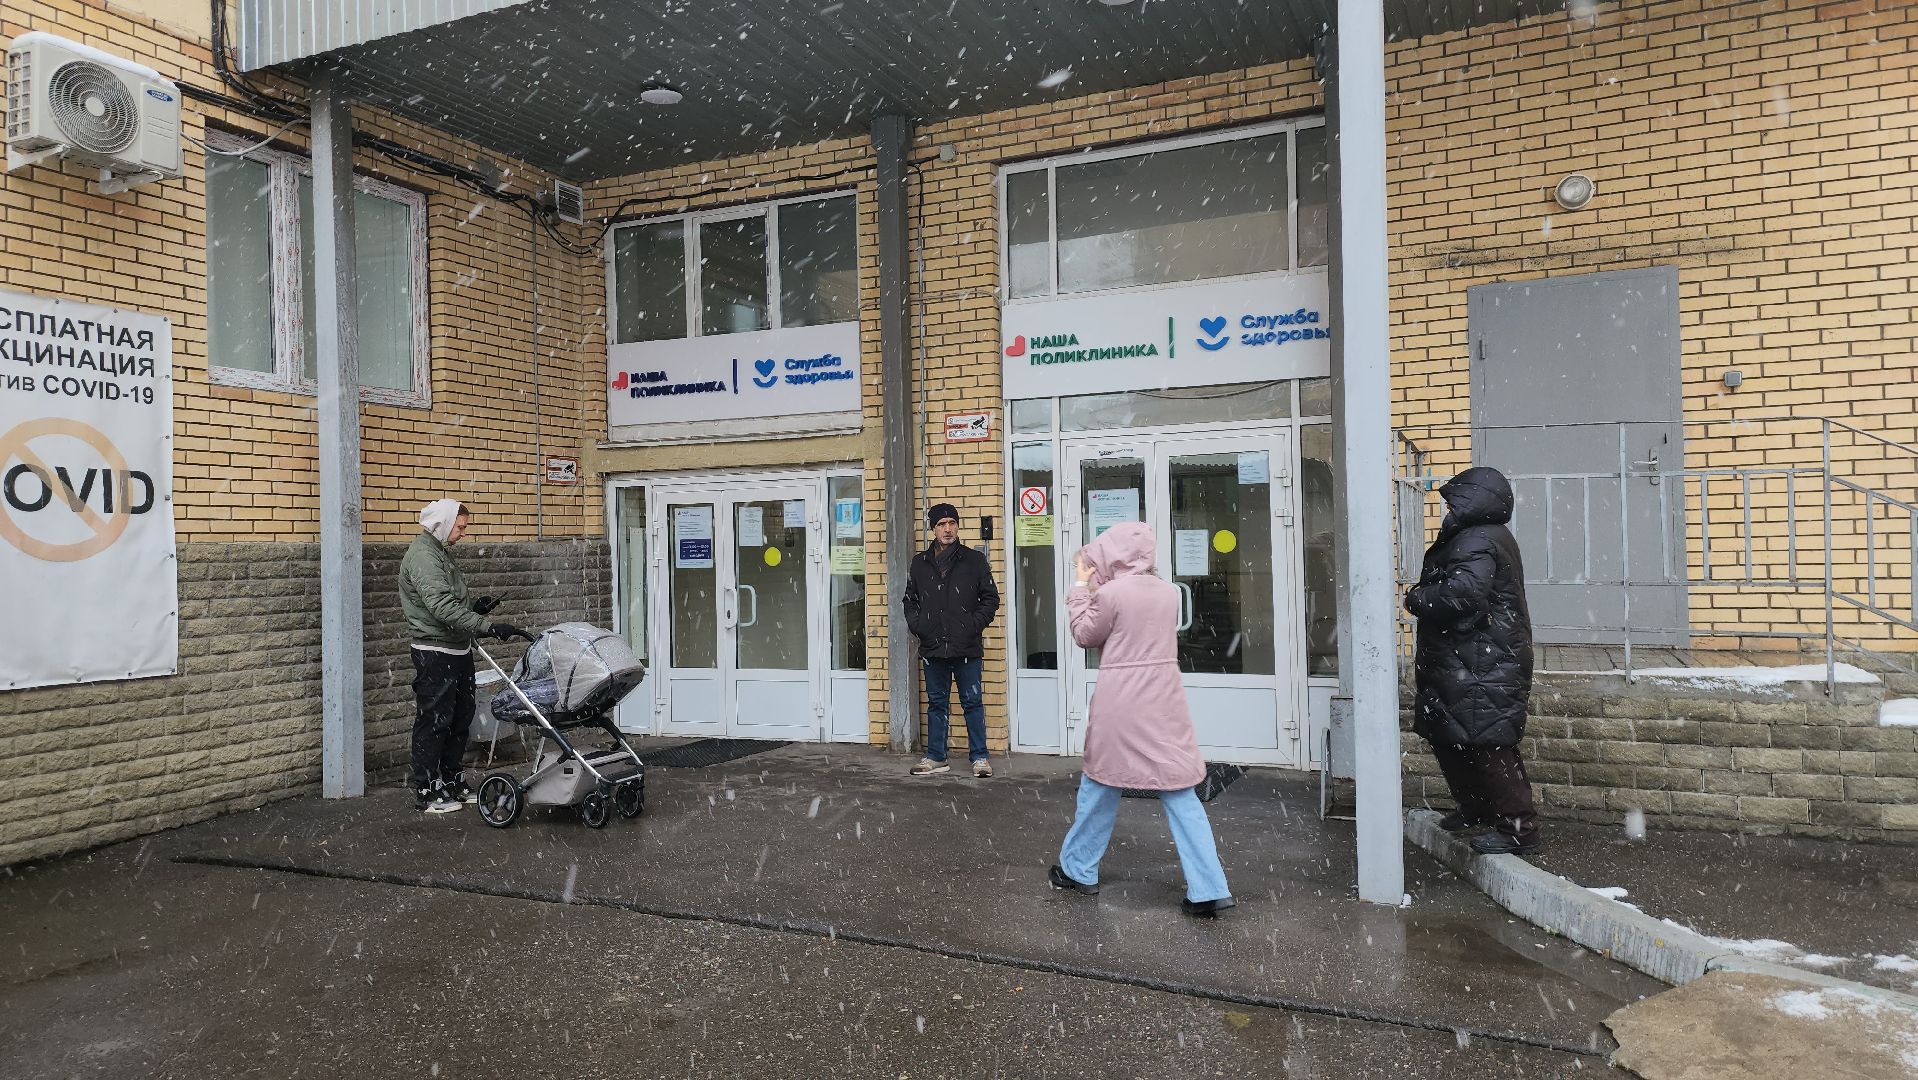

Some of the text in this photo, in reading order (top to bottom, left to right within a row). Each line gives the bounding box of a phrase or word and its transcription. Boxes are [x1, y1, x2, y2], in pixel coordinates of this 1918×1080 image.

[1241, 308, 1319, 329] Служба
[1030, 333, 1079, 349] НАША
[785, 354, 841, 371] Служба
[1030, 343, 1158, 366] ПОЛИКЛИНИКА
[43, 374, 154, 405] COVID-19
[631, 381, 726, 398] ПОЛИКЛИНИКА
[3, 462, 155, 515] OVID
